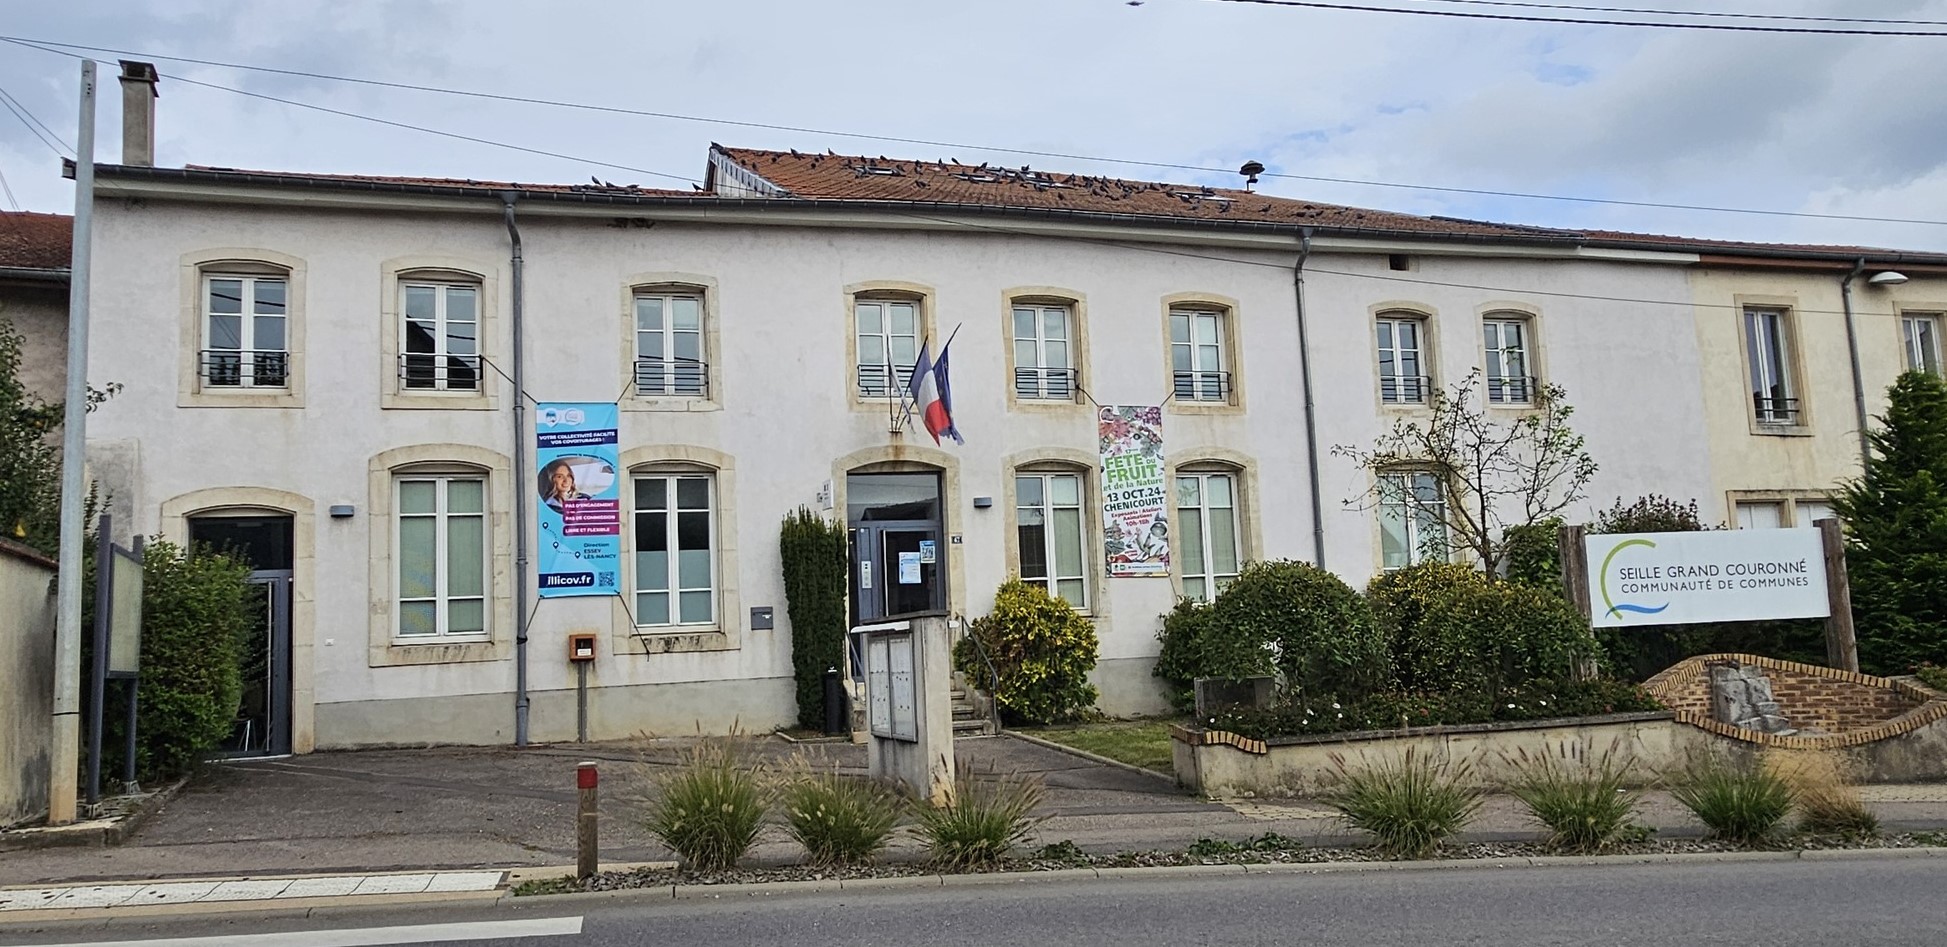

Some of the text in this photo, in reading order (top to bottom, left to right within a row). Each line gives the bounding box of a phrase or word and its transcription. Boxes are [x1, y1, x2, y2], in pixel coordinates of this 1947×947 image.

[1106, 464, 1157, 483] FRUIT
[1136, 478, 1164, 486] Nature
[1107, 486, 1161, 502] 13 OCT.24
[1104, 496, 1164, 512] CHENICOURT
[1620, 558, 1807, 580] SEILLE GRAND COURONNÉ
[547, 574, 592, 585] illicov.fr
[1621, 576, 1809, 594] COMMUNAUTÉ DE COMMUNES
